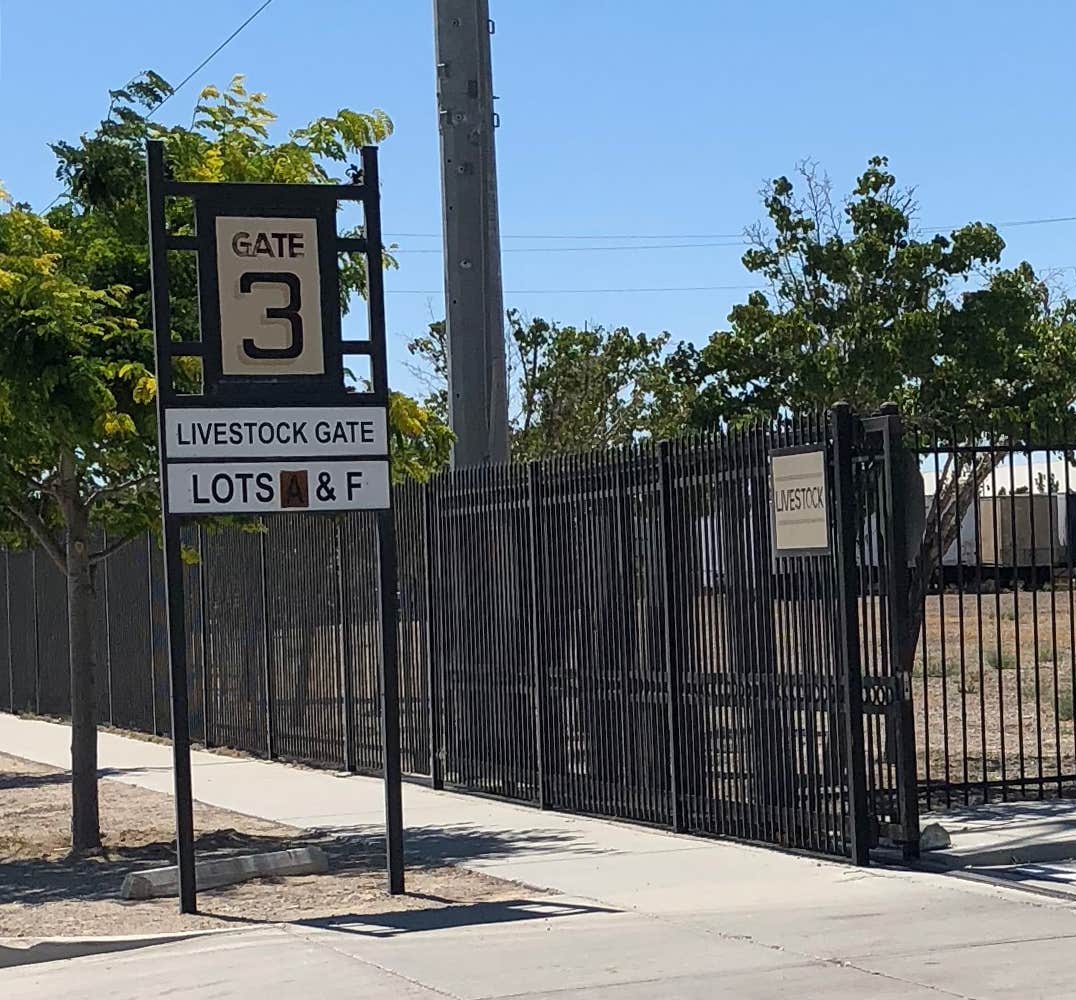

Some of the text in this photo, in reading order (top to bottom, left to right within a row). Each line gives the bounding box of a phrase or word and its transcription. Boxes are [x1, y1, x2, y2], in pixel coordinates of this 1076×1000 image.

[232, 231, 305, 257] GATE
[239, 271, 304, 359] 3
[177, 421, 374, 445] LIVESTOCK GATE
[192, 472, 274, 504] LOTS
[316, 471, 335, 501] &
[347, 472, 362, 501] F
[775, 486, 824, 512] LIVESTOCK
